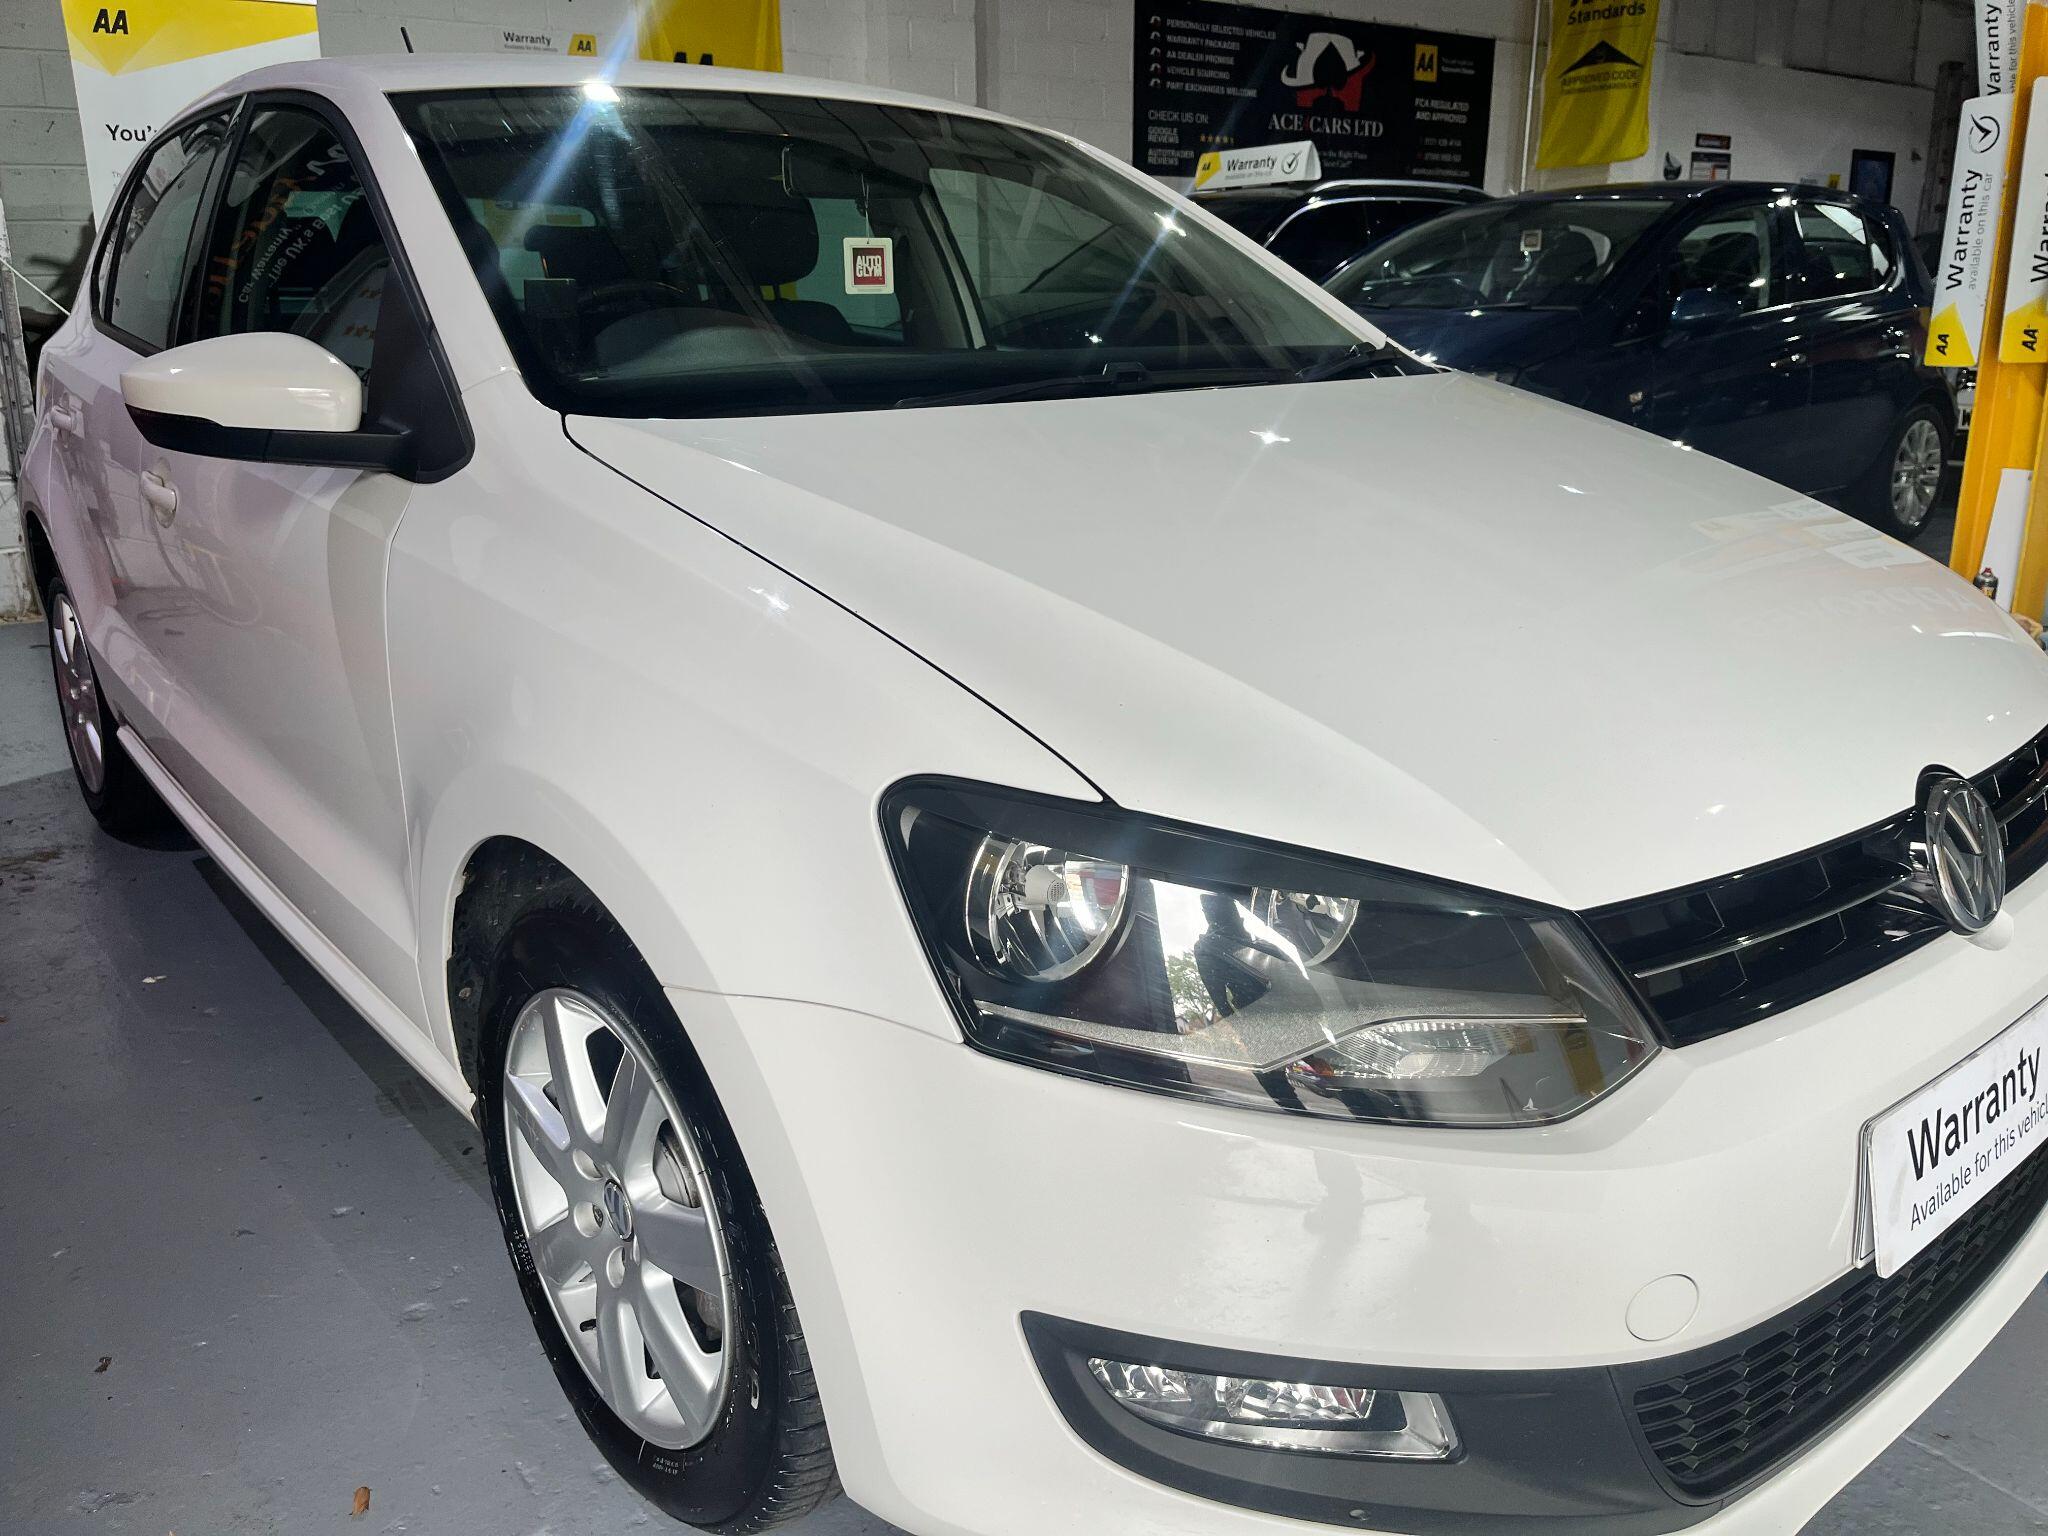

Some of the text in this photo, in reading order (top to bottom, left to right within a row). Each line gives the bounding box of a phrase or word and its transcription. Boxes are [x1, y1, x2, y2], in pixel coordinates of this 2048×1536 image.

[93, 9, 129, 34] AA
[1567, 3, 1646, 25] Standards
[503, 31, 552, 46] Warranty
[577, 40, 592, 52] AA
[1416, 52, 1434, 71] AA
[1148, 109, 1180, 121] CHECK
[1181, 112, 1194, 123] US
[105, 124, 157, 141] You'
[1354, 119, 1384, 137] LTD
[1227, 155, 1277, 171] Warranty
[1946, 169, 1983, 290] Warranty
[1969, 173, 1993, 290] available on this car
[856, 255, 882, 267] AUTO
[856, 265, 882, 278] GLYM
[1936, 333, 1950, 356] AA
[2022, 327, 2039, 352] AA
[1907, 1047, 2041, 1181] Warranty
[1911, 1093, 2048, 1231] Available for this vehicl
